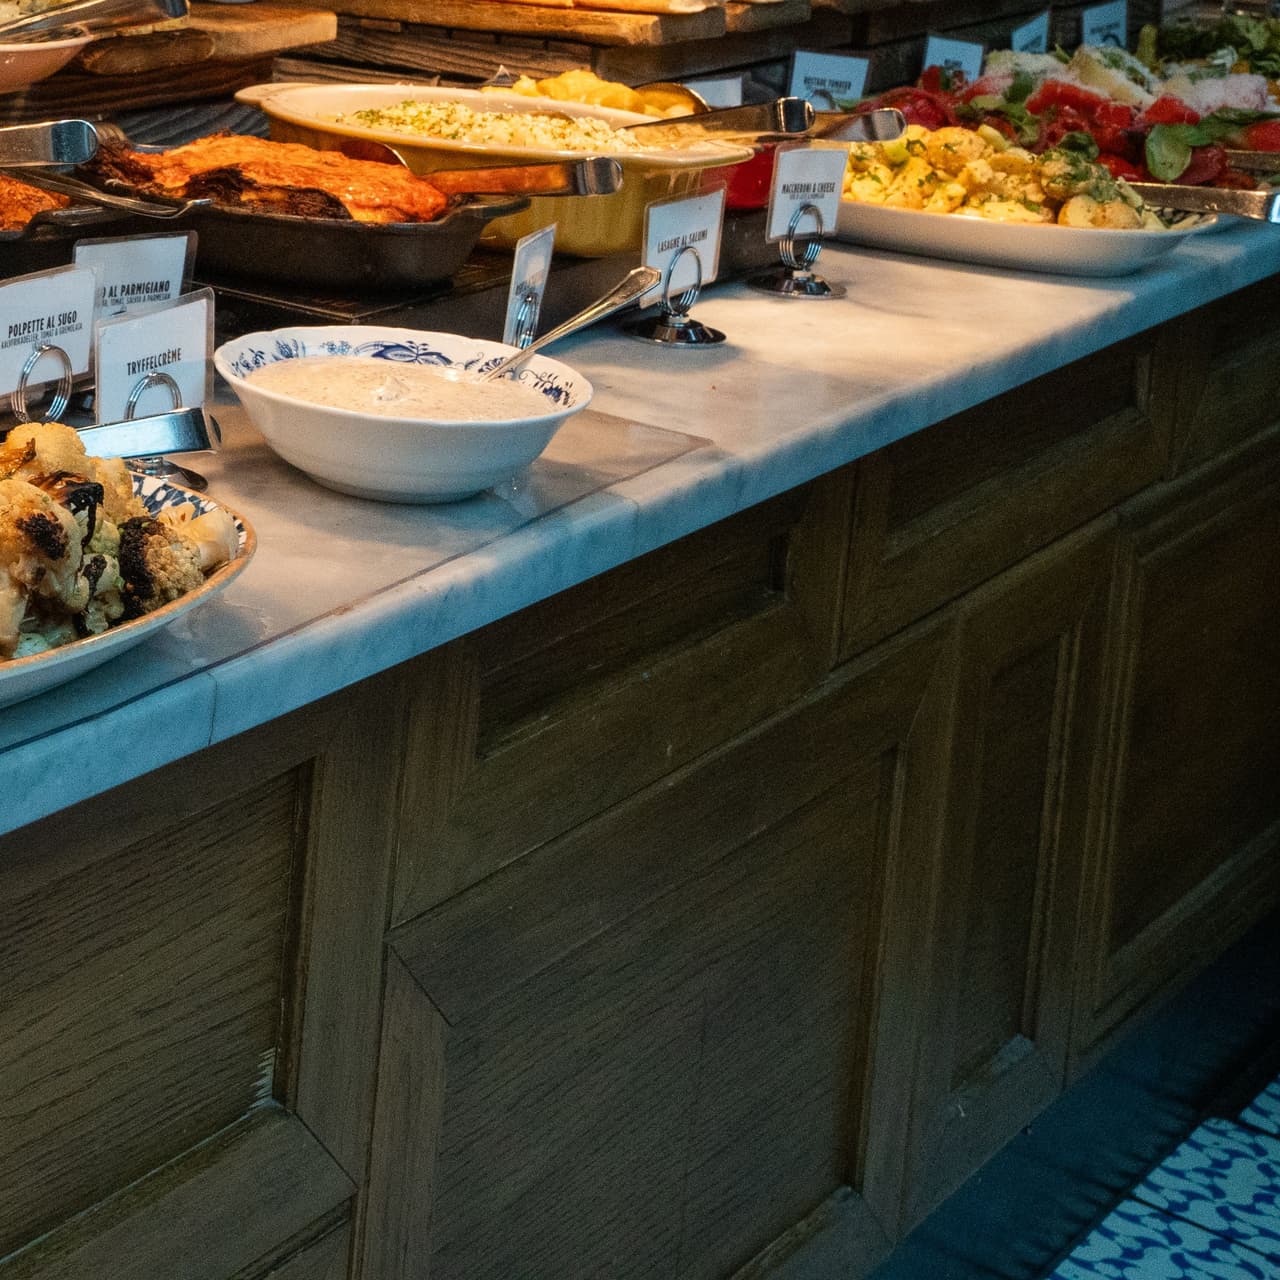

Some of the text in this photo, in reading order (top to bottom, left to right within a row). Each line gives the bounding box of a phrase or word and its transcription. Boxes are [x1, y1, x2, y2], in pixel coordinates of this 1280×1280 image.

[657, 236, 680, 253] LASAGNE
[108, 285, 117, 297] AL
[120, 279, 170, 296] PARMIGIANO
[8, 310, 77, 338] POLPETTE AL SUGO
[127, 347, 182, 376] TRYFFELCRÈME
